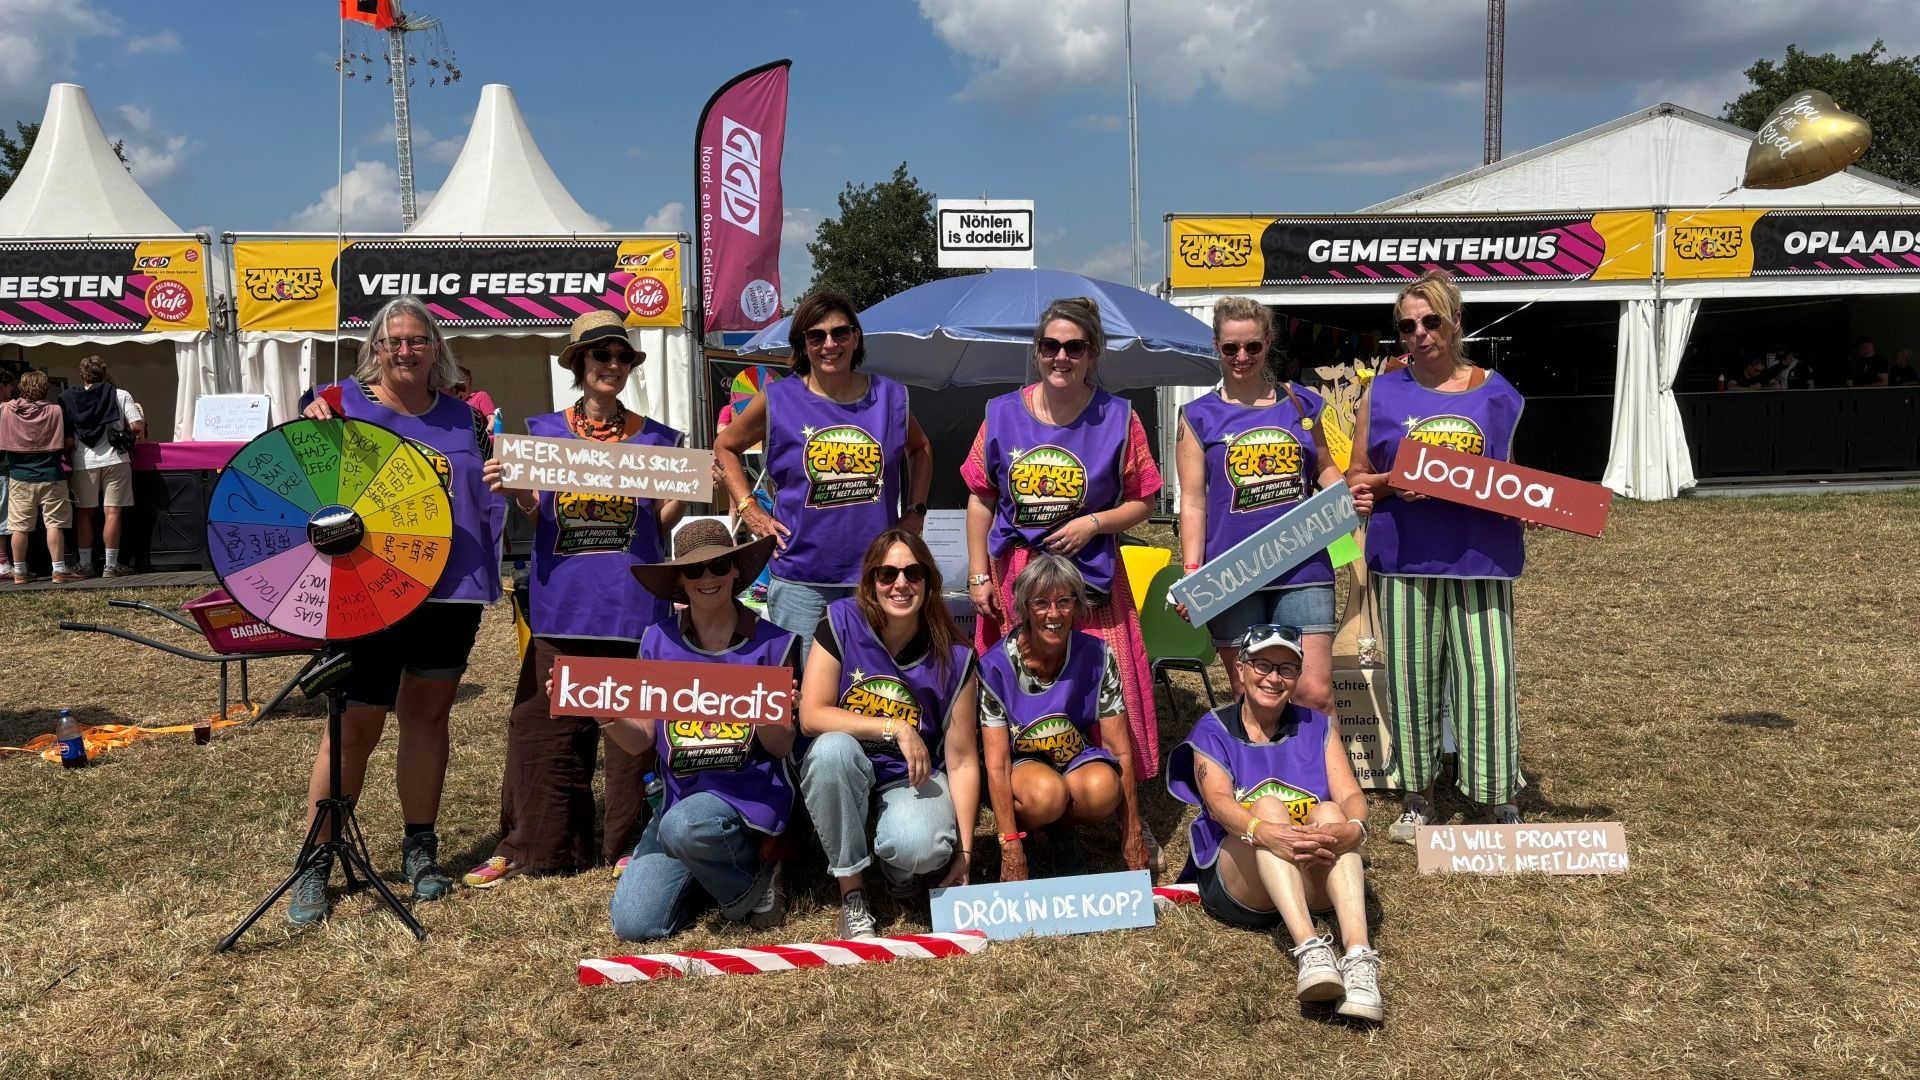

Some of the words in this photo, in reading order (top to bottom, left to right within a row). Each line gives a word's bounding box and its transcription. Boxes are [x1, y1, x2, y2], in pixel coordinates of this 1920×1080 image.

[1779, 95, 1821, 124] You
[724, 126, 759, 225] GGD
[703, 194, 711, 208] en
[960, 214, 1012, 228] Nöhlen
[948, 230, 961, 243] is
[965, 230, 1024, 246] dodelijk
[1181, 235, 1252, 254] ZWARTE
[1675, 227, 1743, 247] ZWARTE
[1184, 249, 1247, 268] CROSS
[1308, 235, 1558, 263] GEMEENTEHUIS
[1678, 241, 1737, 260] CROSS
[139, 256, 169, 268] GGD
[620, 255, 649, 265] GGD
[246, 269, 322, 287] ZWARTE
[358, 272, 461, 296] VEILIG
[469, 272, 606, 295] FEESTEN
[251, 282, 316, 300] CROSS
[630, 289, 664, 308] Safe
[151, 292, 187, 311] Safe
[502, 437, 562, 464] MEER
[565, 447, 615, 470] WARK
[618, 453, 645, 471] ALS
[808, 441, 881, 460] ZWARTE
[1229, 442, 1300, 464] ZWARTE
[812, 453, 881, 475] CROSS
[1011, 463, 1084, 482] ZWARTE
[1233, 456, 1300, 478] CROSS
[502, 462, 524, 482] OF
[529, 468, 580, 487] MEER
[618, 475, 648, 490] DAN
[1015, 477, 1084, 498] CROSS
[559, 665, 633, 711] kats
[640, 679, 667, 712] in
[1331, 681, 1370, 691] Achter
[1337, 715, 1380, 725] imlach
[675, 720, 750, 740] CROSS
[1355, 734, 1376, 743] een
[1566, 851, 1630, 870] LOATEN
[1053, 894, 1079, 919] DE
[1082, 889, 1144, 919] KOP?
